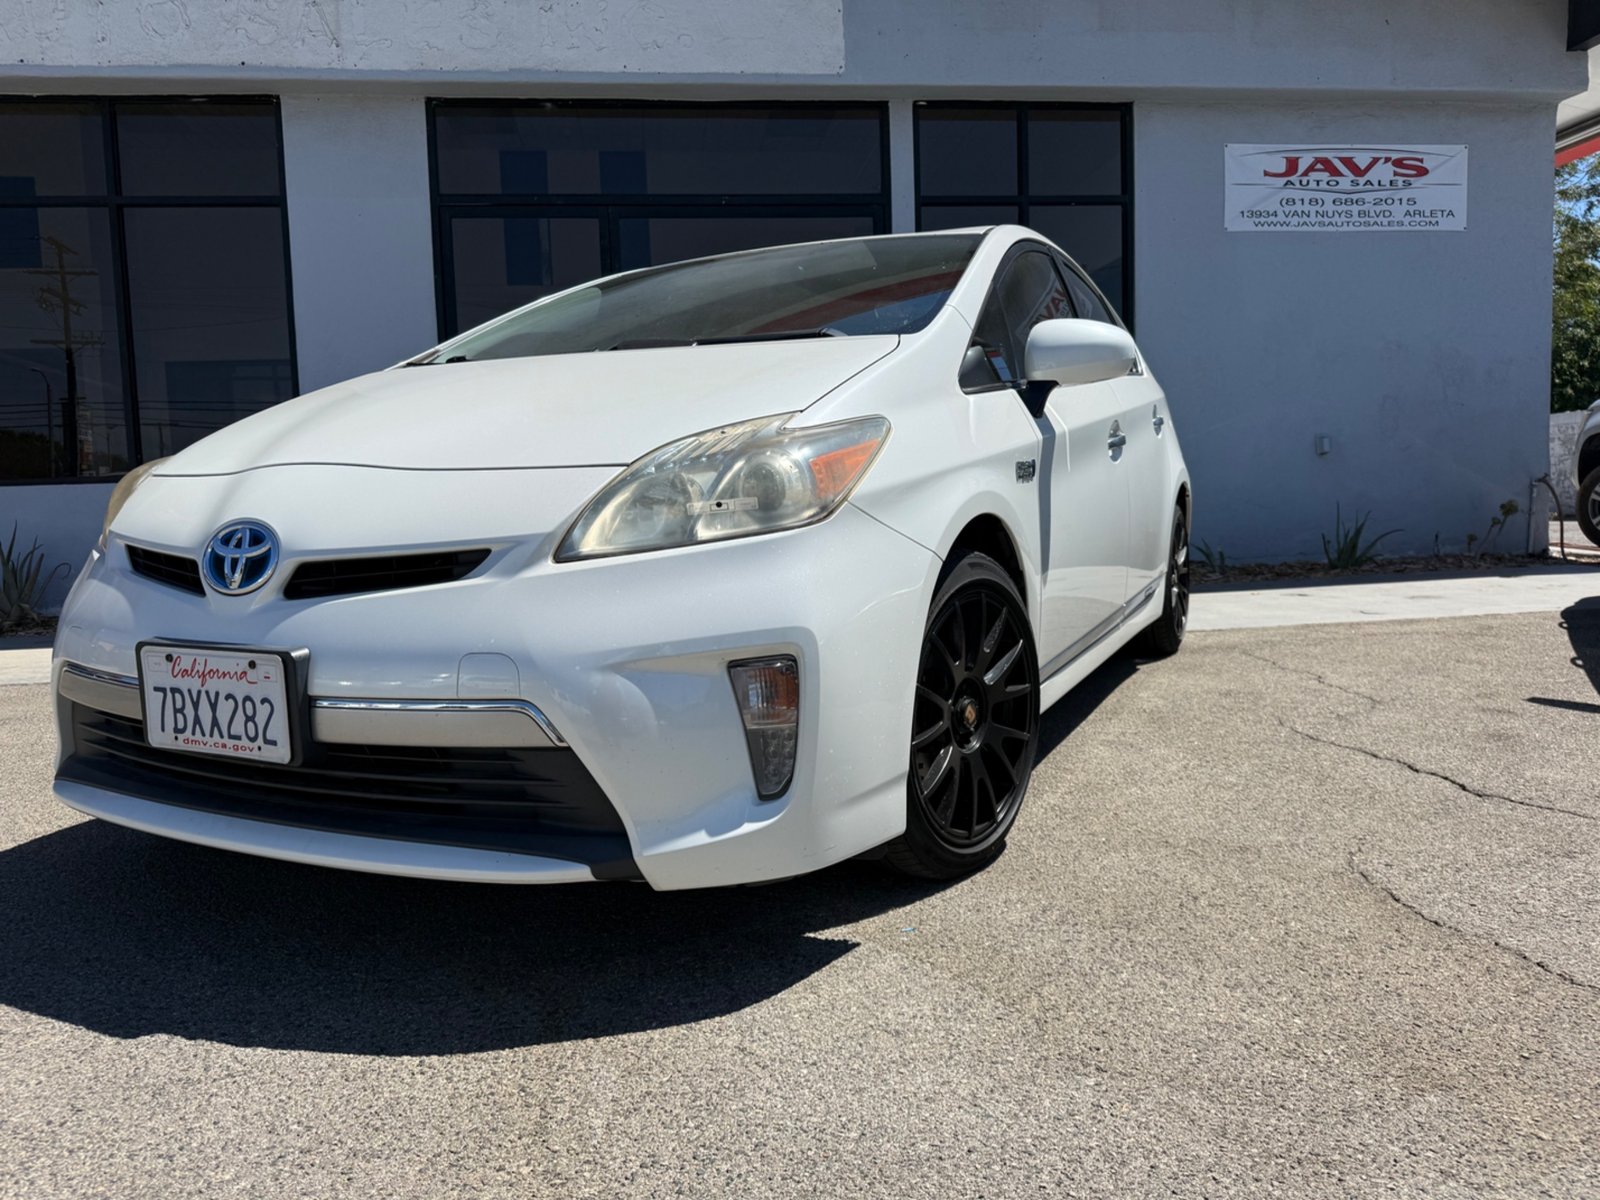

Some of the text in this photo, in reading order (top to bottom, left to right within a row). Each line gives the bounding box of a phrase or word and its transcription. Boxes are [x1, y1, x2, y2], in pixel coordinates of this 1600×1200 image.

[1263, 156, 1430, 178] JAV'S
[1283, 179, 1413, 187] AUTO SALES
[1279, 197, 1417, 207] (818) 686-2015
[1239, 210, 1455, 219] 13934 VAN NUYS BLVD. ARLETA
[1252, 220, 1440, 228] WWW.JAVSAUTOSALES.COM
[171, 655, 258, 687] California
[153, 686, 278, 747] 7BXX282
[183, 737, 255, 752] dmv.ca.gov
